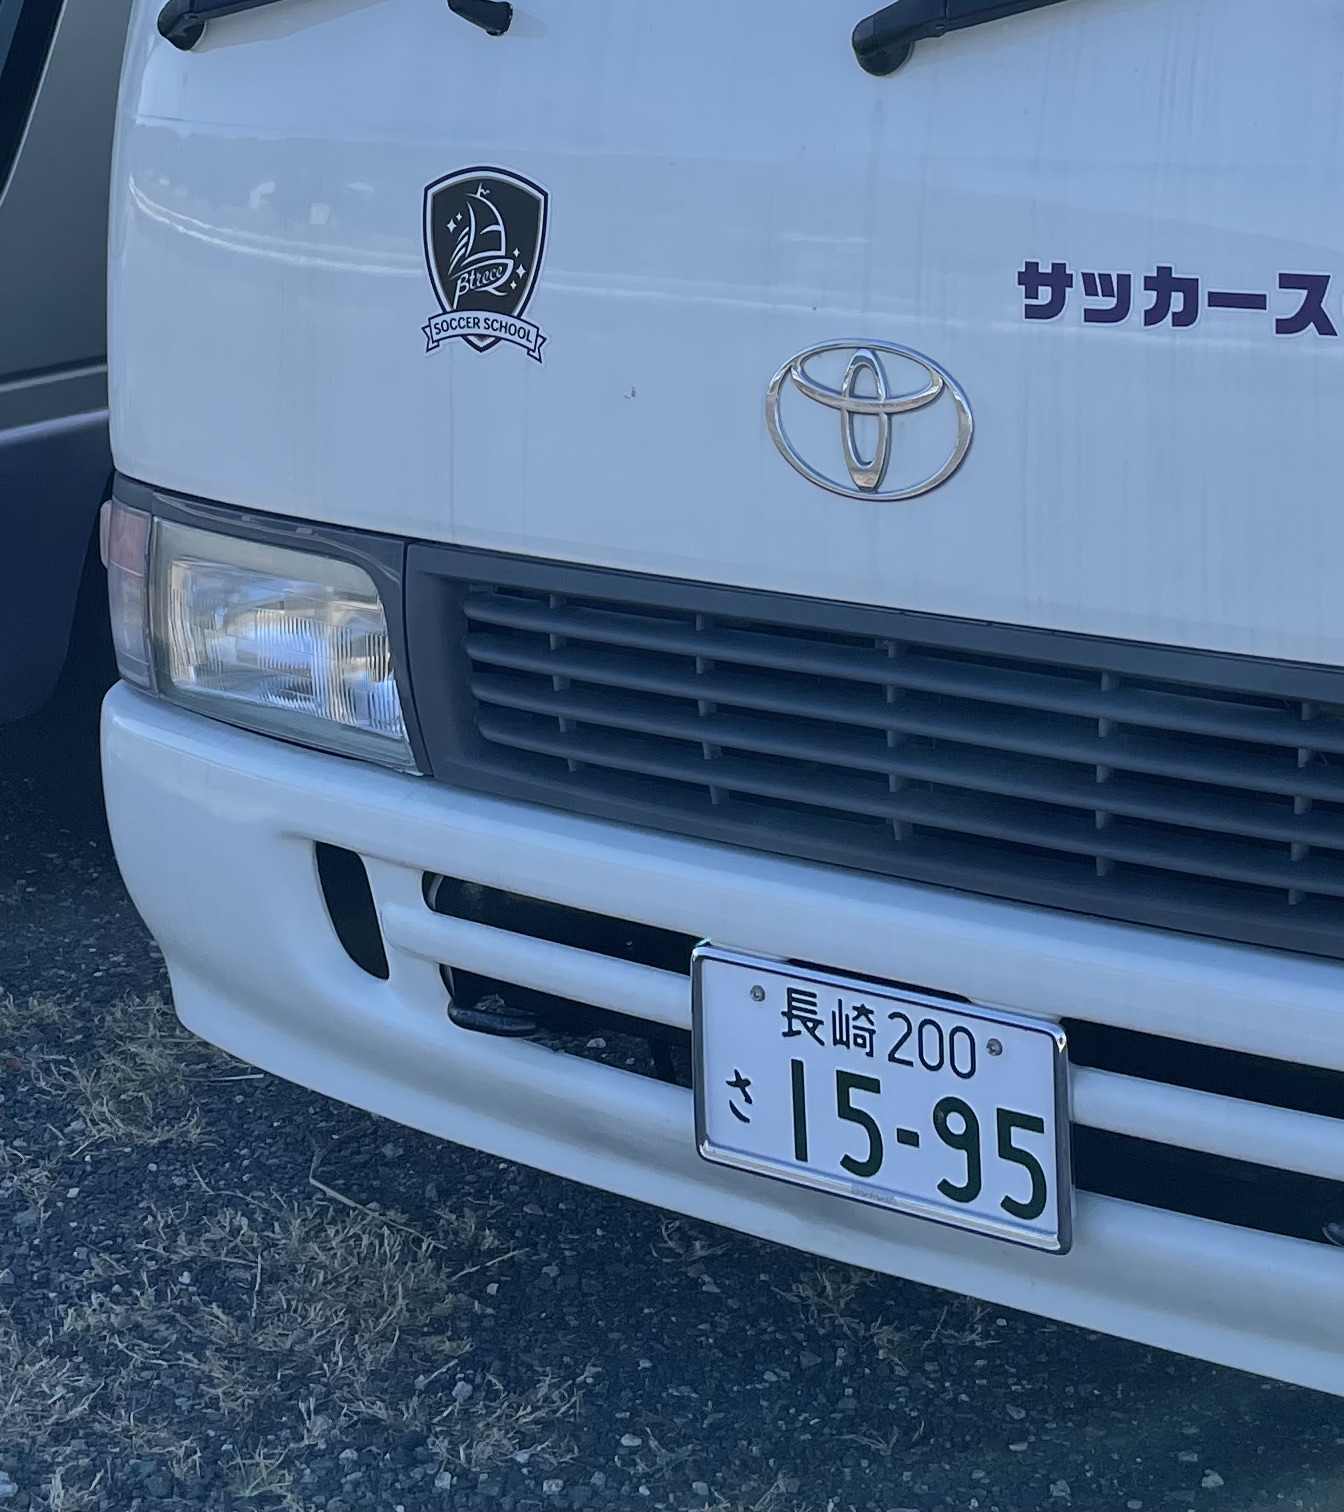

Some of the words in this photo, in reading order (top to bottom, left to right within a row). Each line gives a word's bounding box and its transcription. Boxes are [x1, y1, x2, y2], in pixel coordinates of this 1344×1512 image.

[434, 317, 480, 336] SOCCER
[484, 318, 533, 343] SCHOOL
[726, 1068, 753, 1124] さ
[791, 1058, 1047, 1220] 15-95
